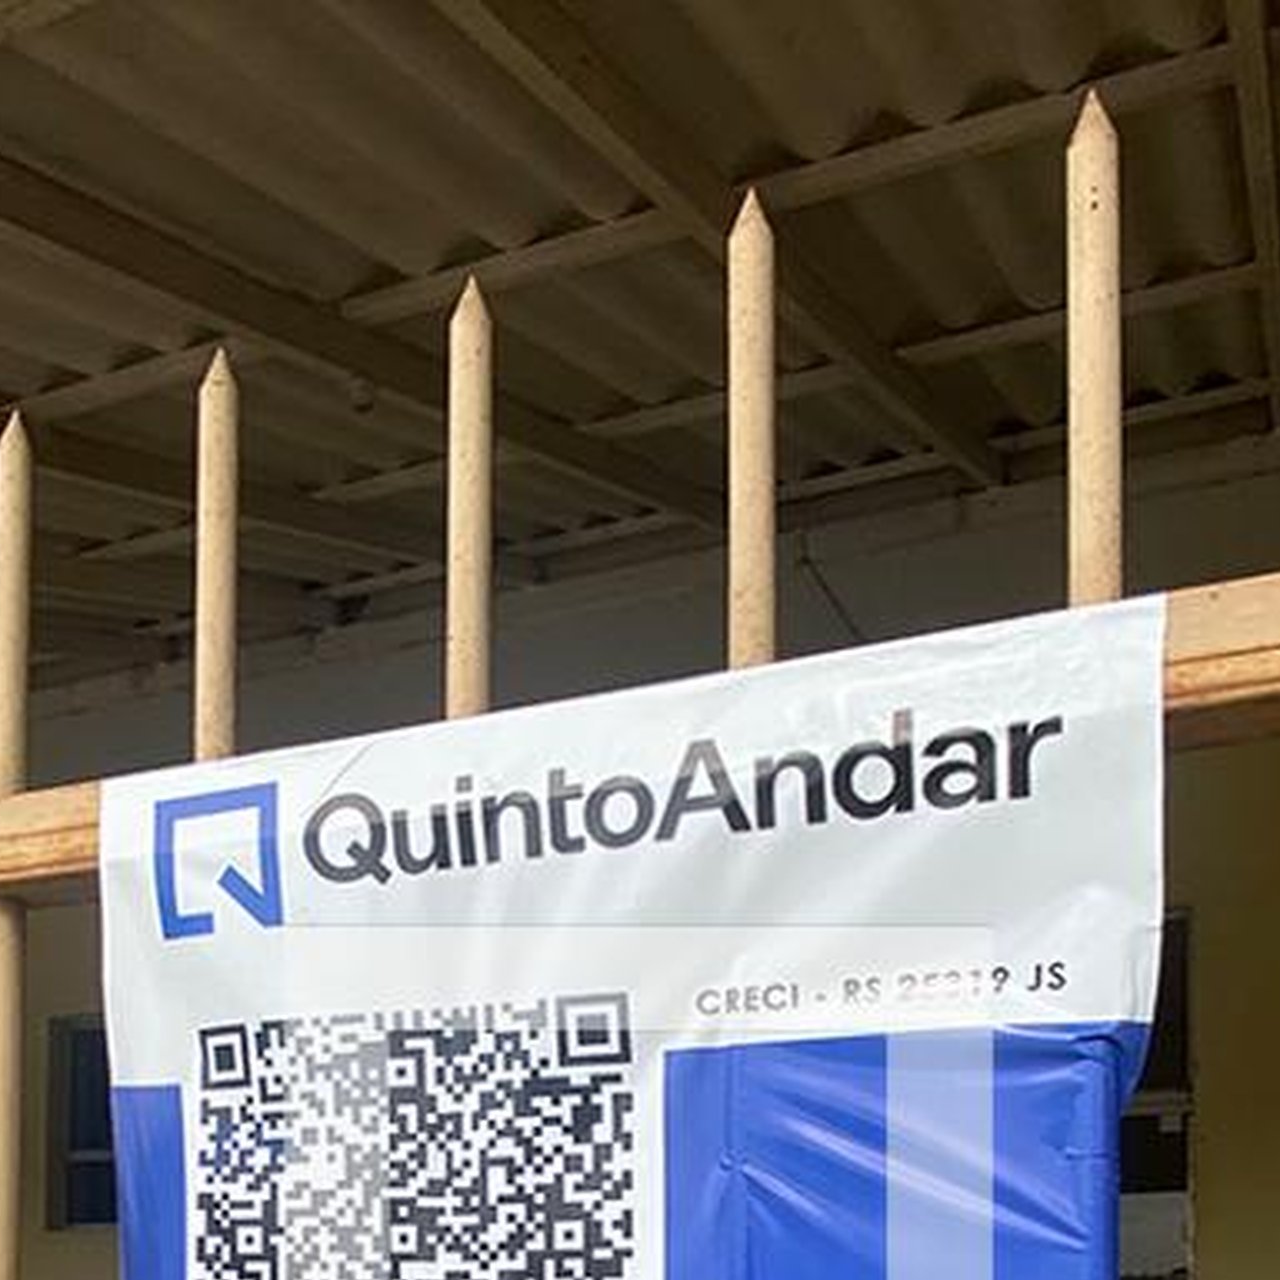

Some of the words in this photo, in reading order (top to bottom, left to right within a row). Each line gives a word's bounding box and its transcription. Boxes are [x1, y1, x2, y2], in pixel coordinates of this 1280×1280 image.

[304, 712, 1063, 886] QuintoAndar
[695, 984, 800, 1015] CRECI
[843, 977, 881, 1006] RS
[1026, 962, 1067, 992] JS
